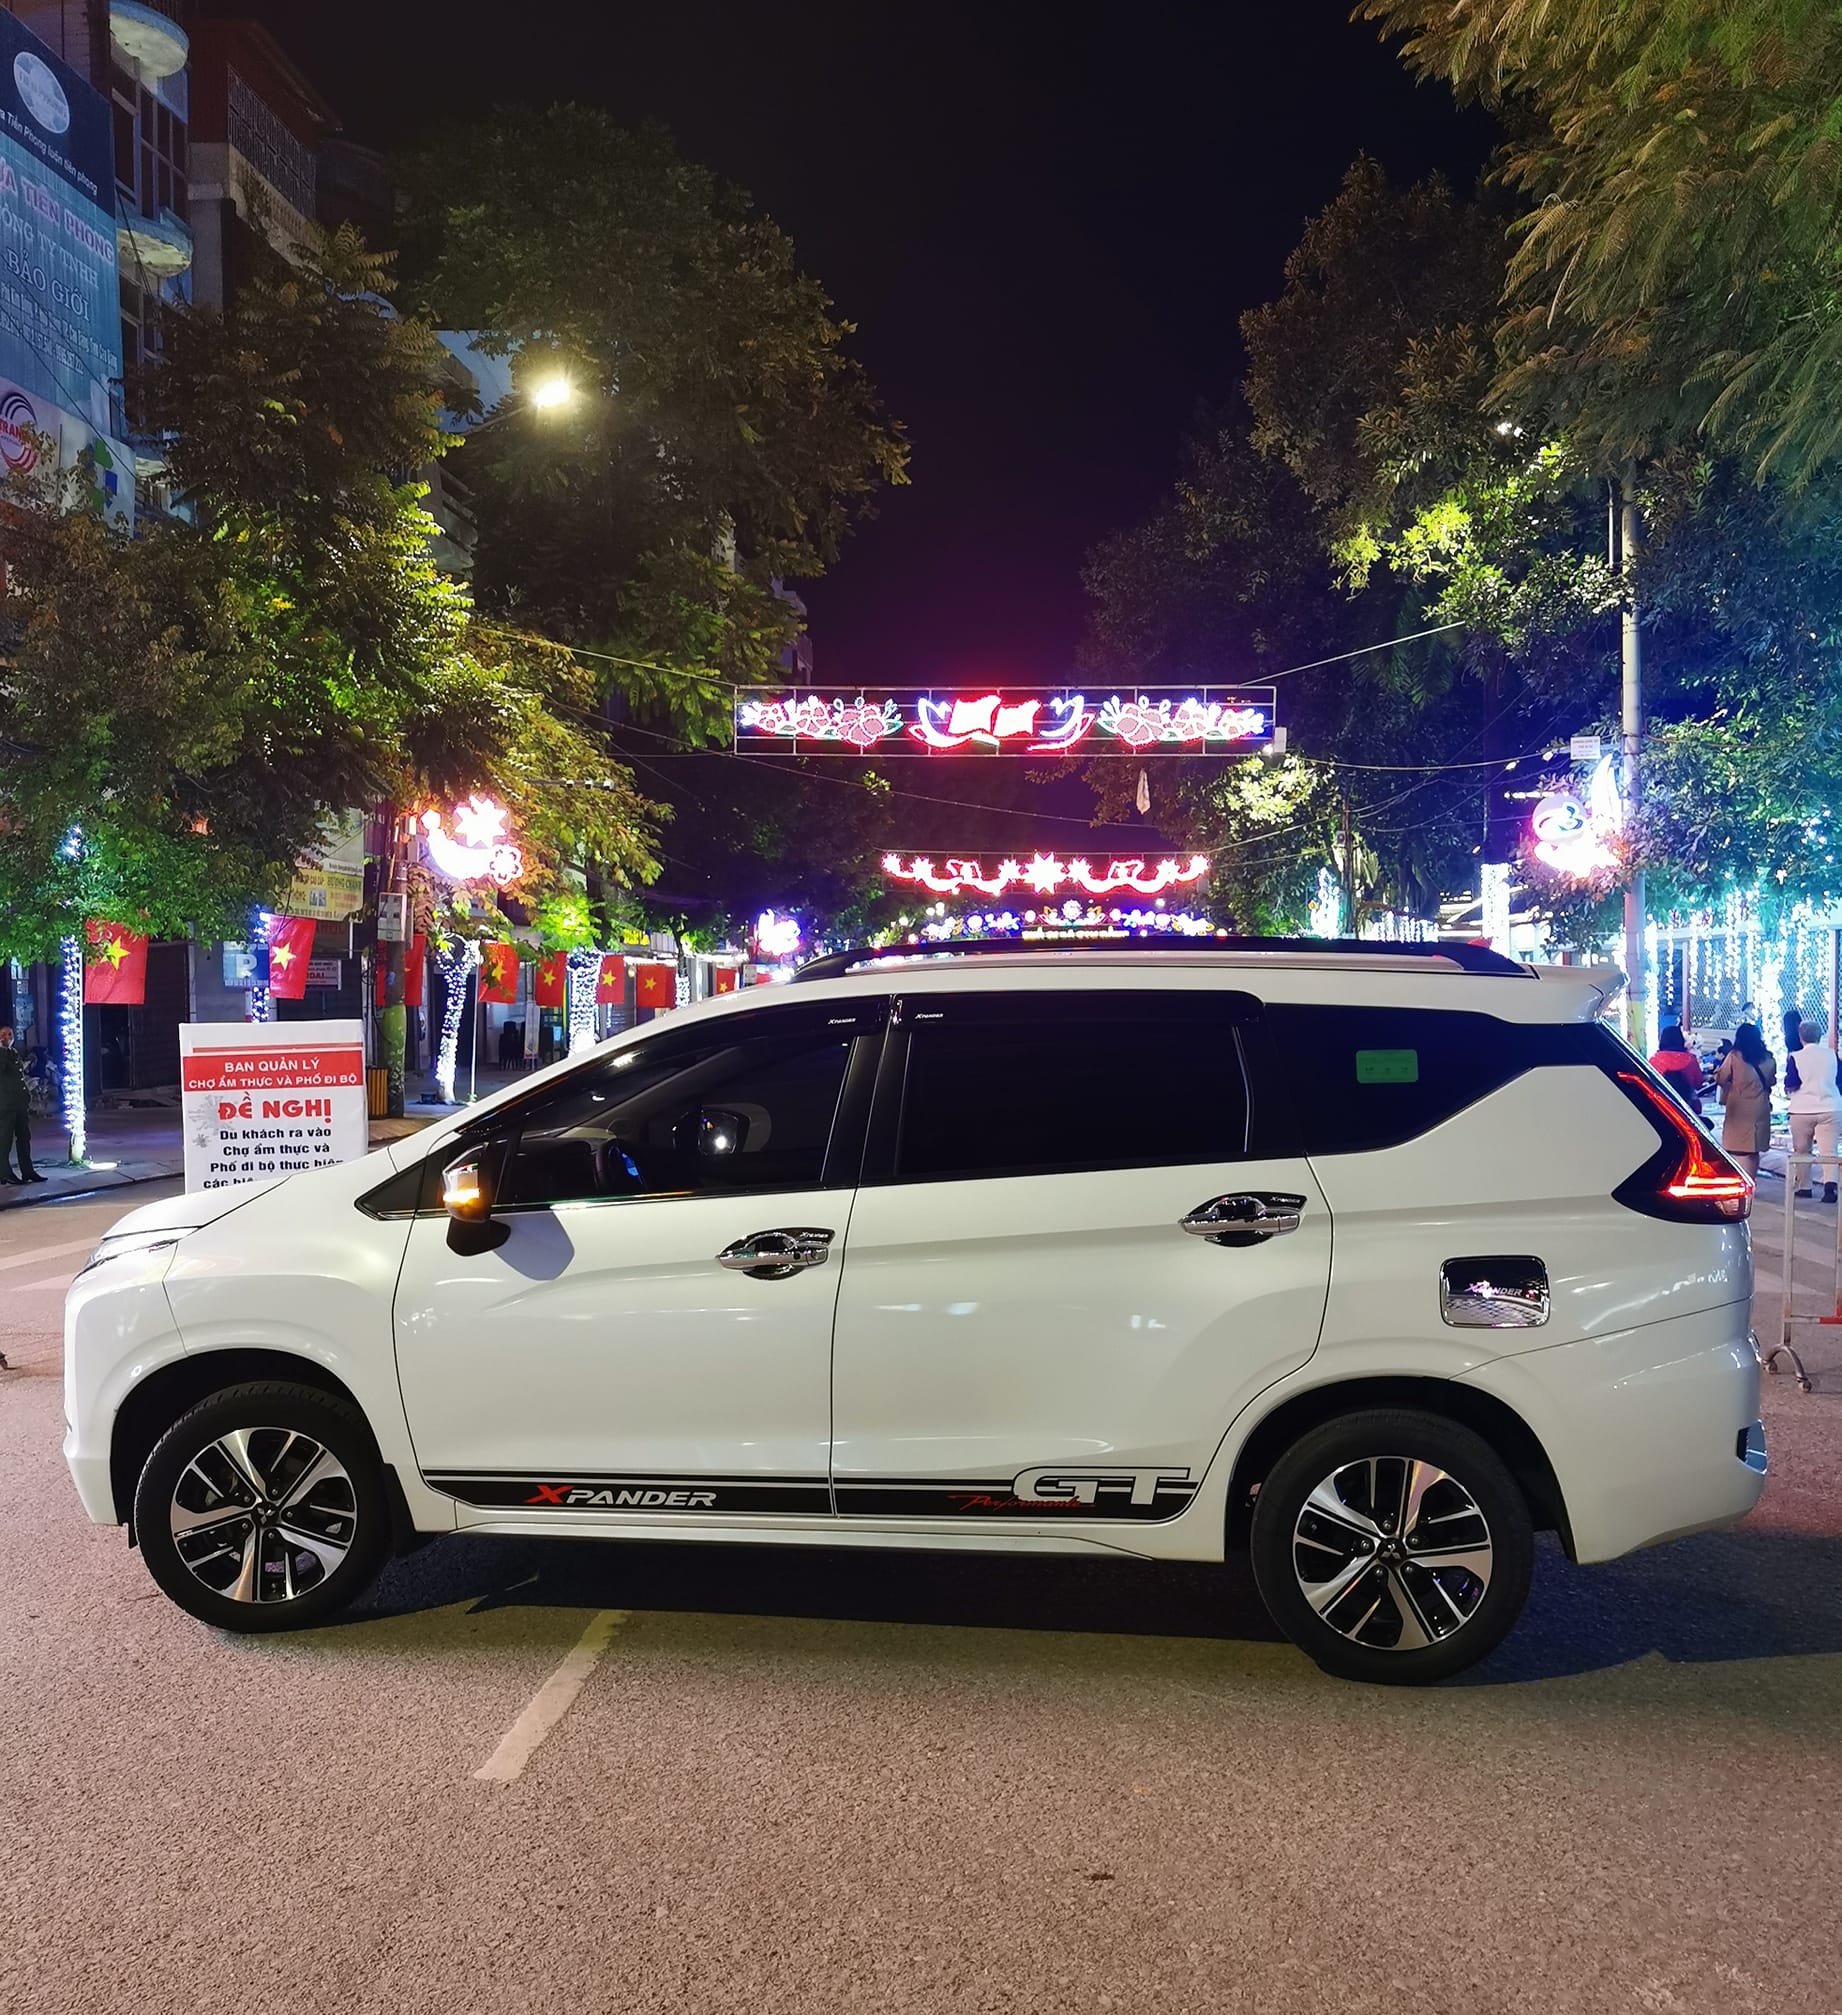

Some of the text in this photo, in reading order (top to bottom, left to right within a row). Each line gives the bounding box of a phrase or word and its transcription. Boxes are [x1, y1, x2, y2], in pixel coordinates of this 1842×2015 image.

[64, 208, 114, 266] PHONG
[1, 203, 98, 289] ÔNG TY TNHH
[224, 1056, 319, 1072] BAN QUẢN LÝ
[188, 1078, 215, 1089] CHỢ
[240, 1076, 273, 1087] THỰC
[276, 1074, 292, 1086] VÀ
[296, 1072, 321, 1085] PHỐ
[324, 1075, 336, 1084] ĐI
[340, 1072, 357, 1085] BỘ
[218, 1091, 331, 1124] ĐỀ NGHỊ
[220, 1126, 331, 1140] Du khách ra vào
[223, 1146, 250, 1157] Chợ
[280, 1144, 310, 1155] thực
[314, 1143, 330, 1152] và
[210, 1160, 237, 1172] Phố
[258, 1160, 275, 1172] bộ
[1464, 1283, 1523, 1297] XNDER
[1012, 1465, 1191, 1506] GT
[524, 1484, 717, 1507] XPANDER
